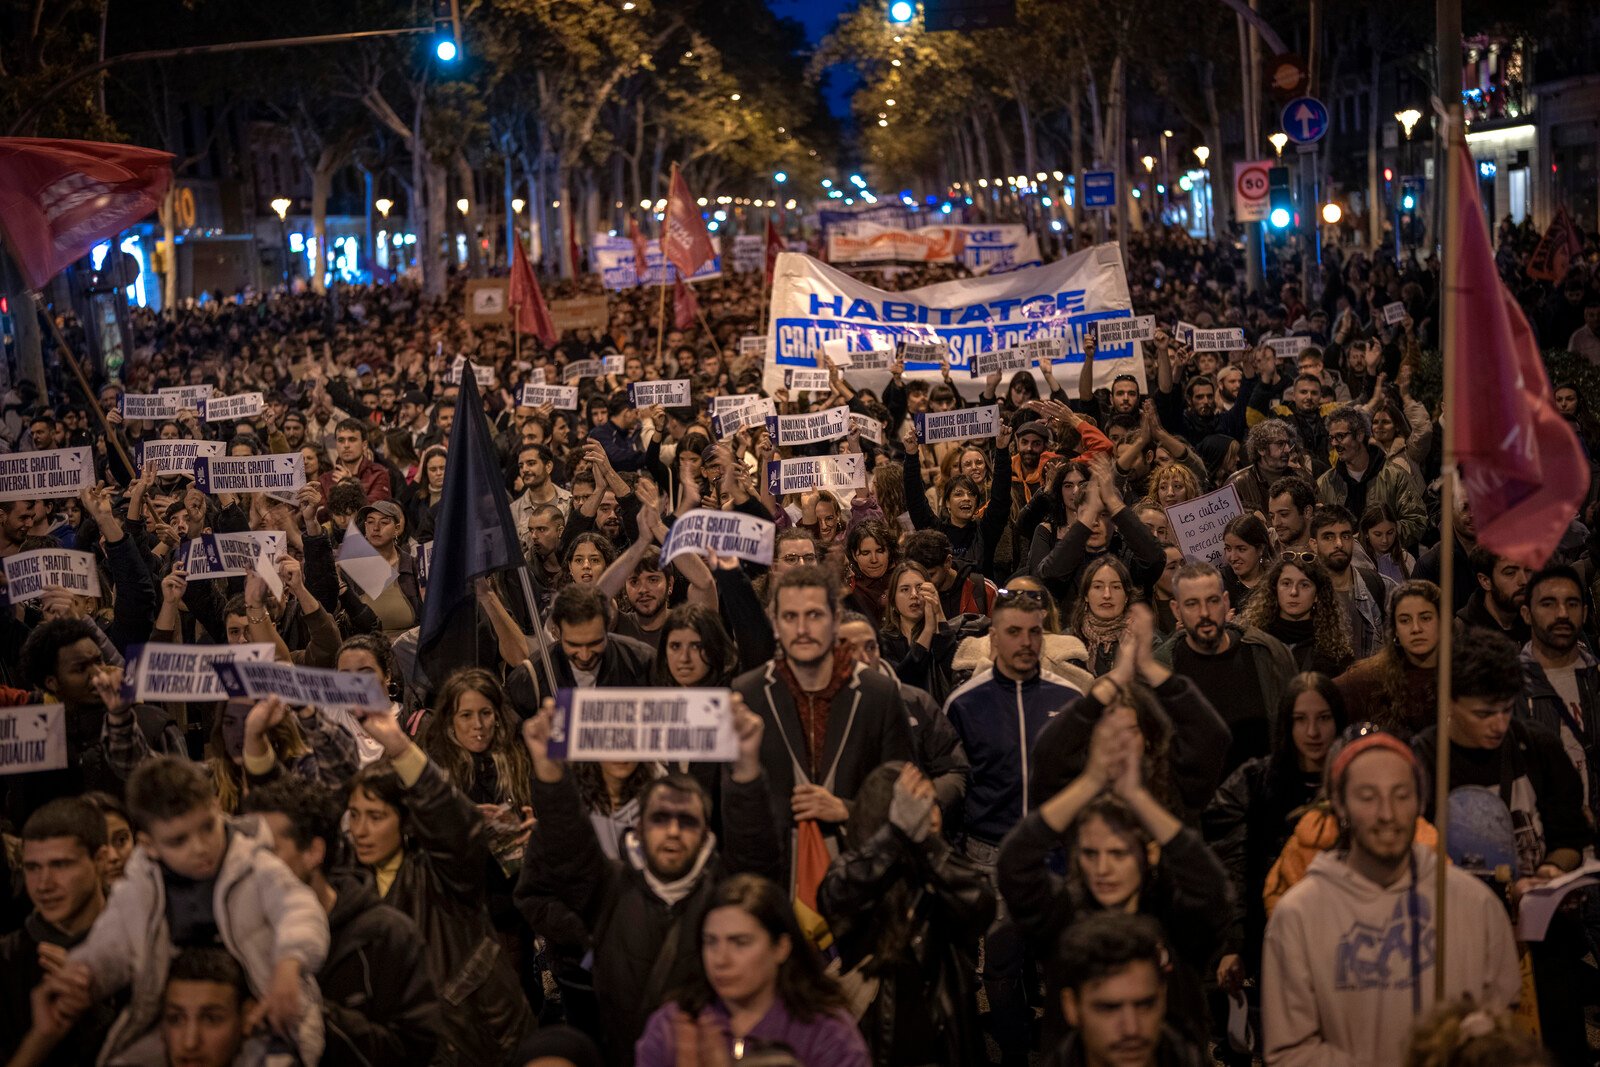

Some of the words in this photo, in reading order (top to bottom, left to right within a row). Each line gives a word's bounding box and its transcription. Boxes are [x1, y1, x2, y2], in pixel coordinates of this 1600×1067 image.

[1246, 178, 1264, 190] 50
[810, 289, 1085, 325] HABITATGE
[968, 421, 993, 436] QUALITAT
[145, 445, 172, 459] HABITATGE
[0, 458, 28, 476] BITATGE
[212, 461, 247, 476] HABITATGE
[783, 461, 814, 477] HABITATGE
[38, 472, 48, 489] DE
[48, 469, 82, 488] QUALITAT
[213, 475, 249, 490] UNIVERSAL
[254, 473, 263, 488] DE
[264, 472, 293, 487] QUALITAT
[1178, 512, 1196, 524] Les
[1198, 496, 1230, 518] ciutats
[1184, 530, 1196, 538] no
[1189, 532, 1223, 554] mercade
[722, 535, 760, 555] QUALITAT
[61, 572, 89, 590] QUALITAT
